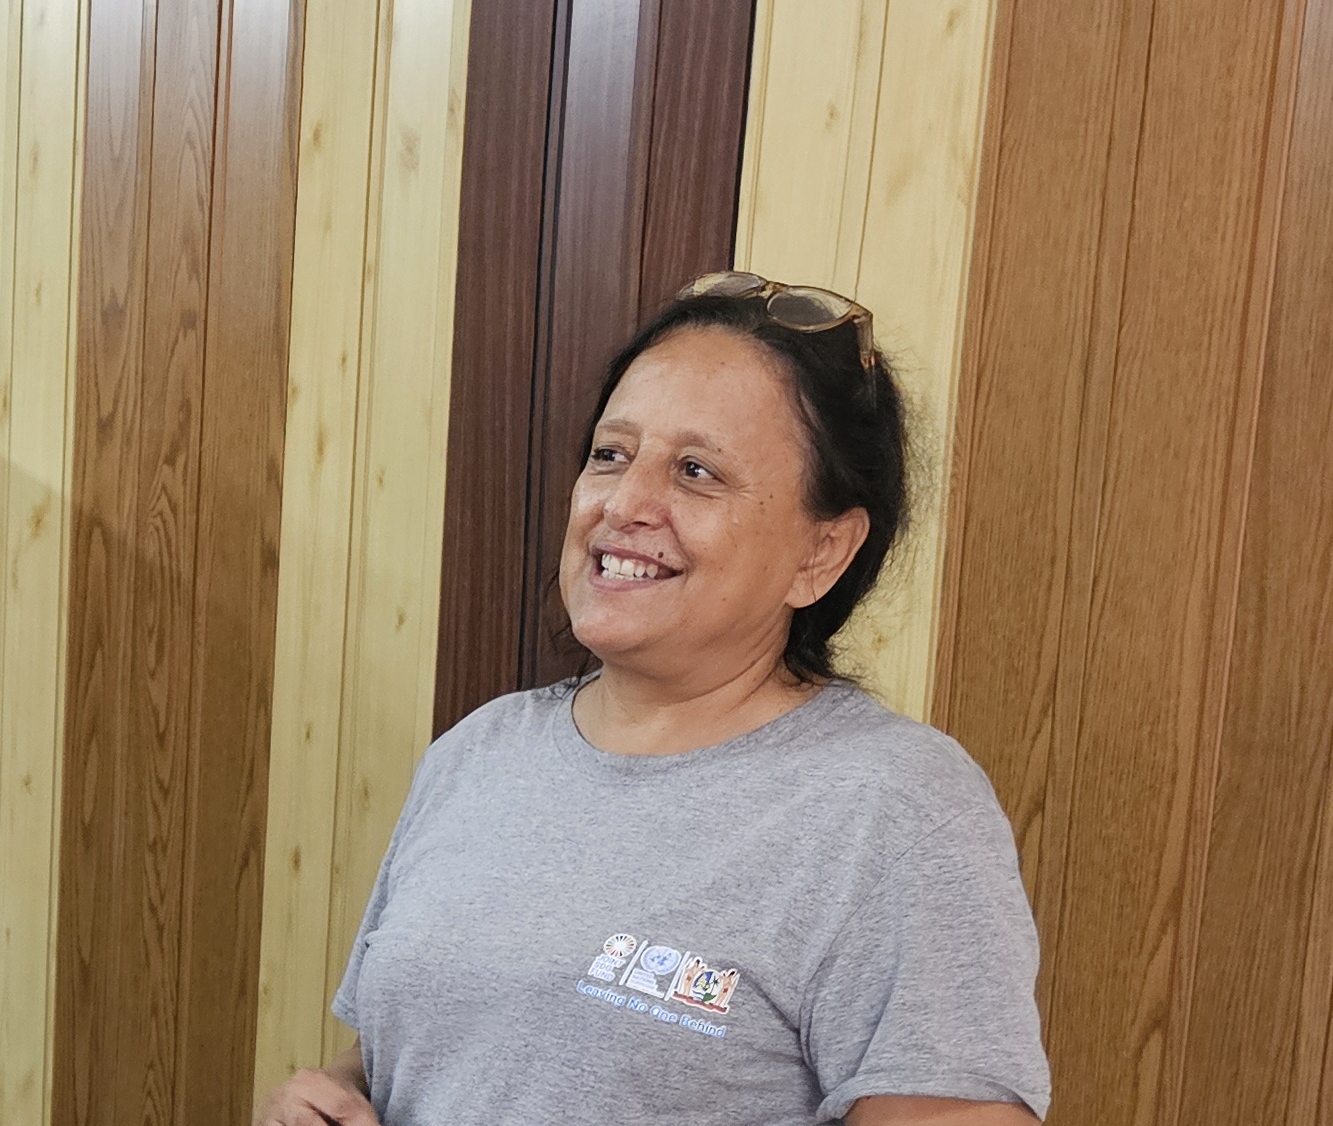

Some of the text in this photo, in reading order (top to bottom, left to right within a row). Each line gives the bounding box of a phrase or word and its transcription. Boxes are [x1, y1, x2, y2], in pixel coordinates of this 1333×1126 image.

[576, 979, 628, 1009] Leaving
[626, 997, 649, 1014] No
[649, 1005, 679, 1024] One
[679, 1013, 729, 1039] Behind
